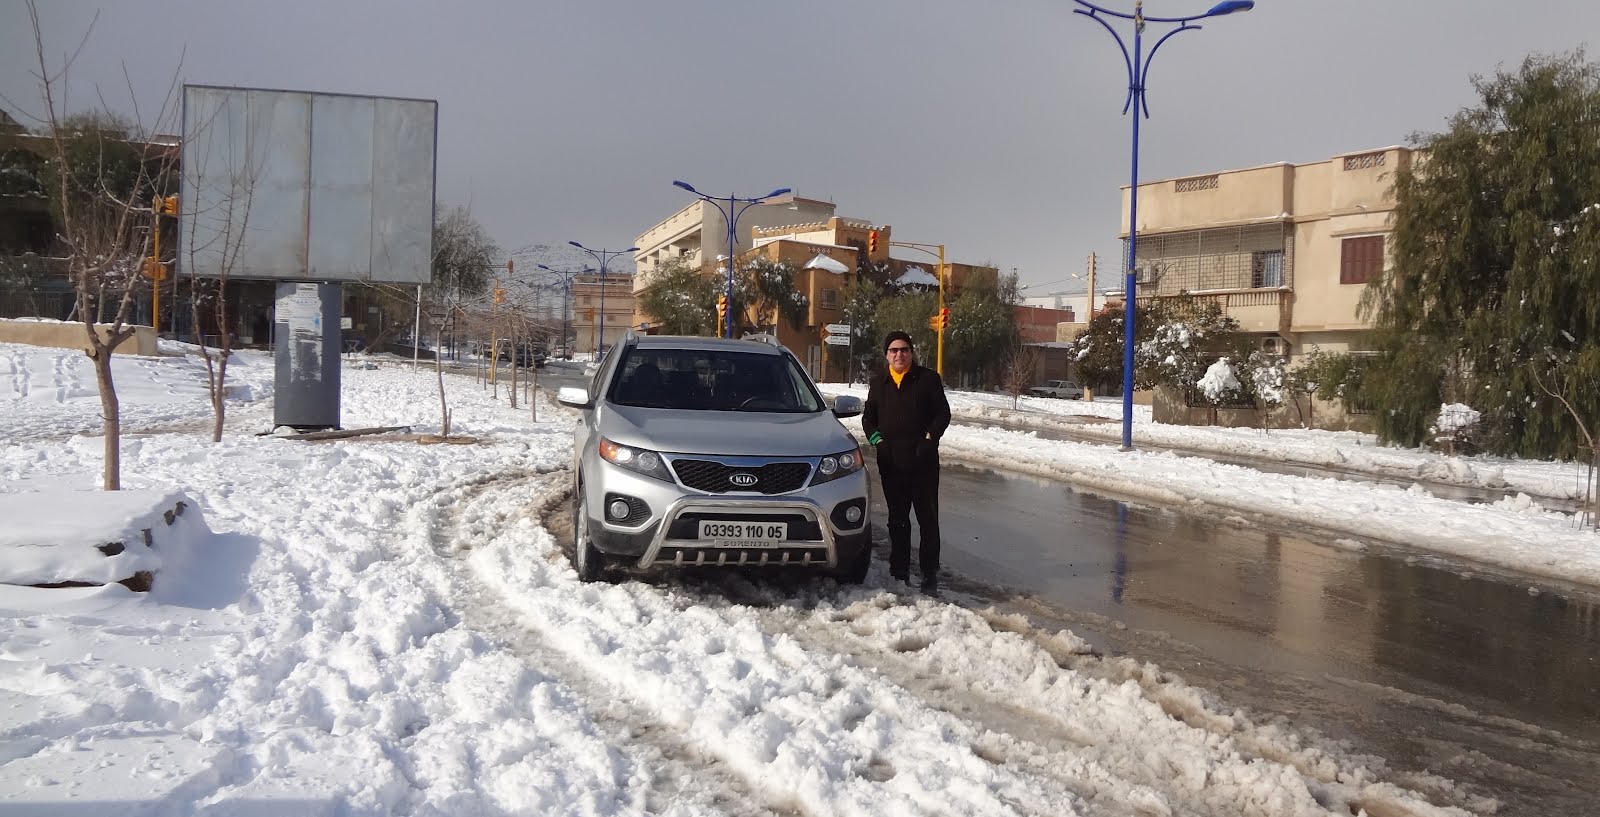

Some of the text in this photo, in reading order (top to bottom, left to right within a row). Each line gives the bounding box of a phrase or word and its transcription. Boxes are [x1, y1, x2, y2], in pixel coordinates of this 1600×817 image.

[704, 524, 783, 538] 03393 110 05
